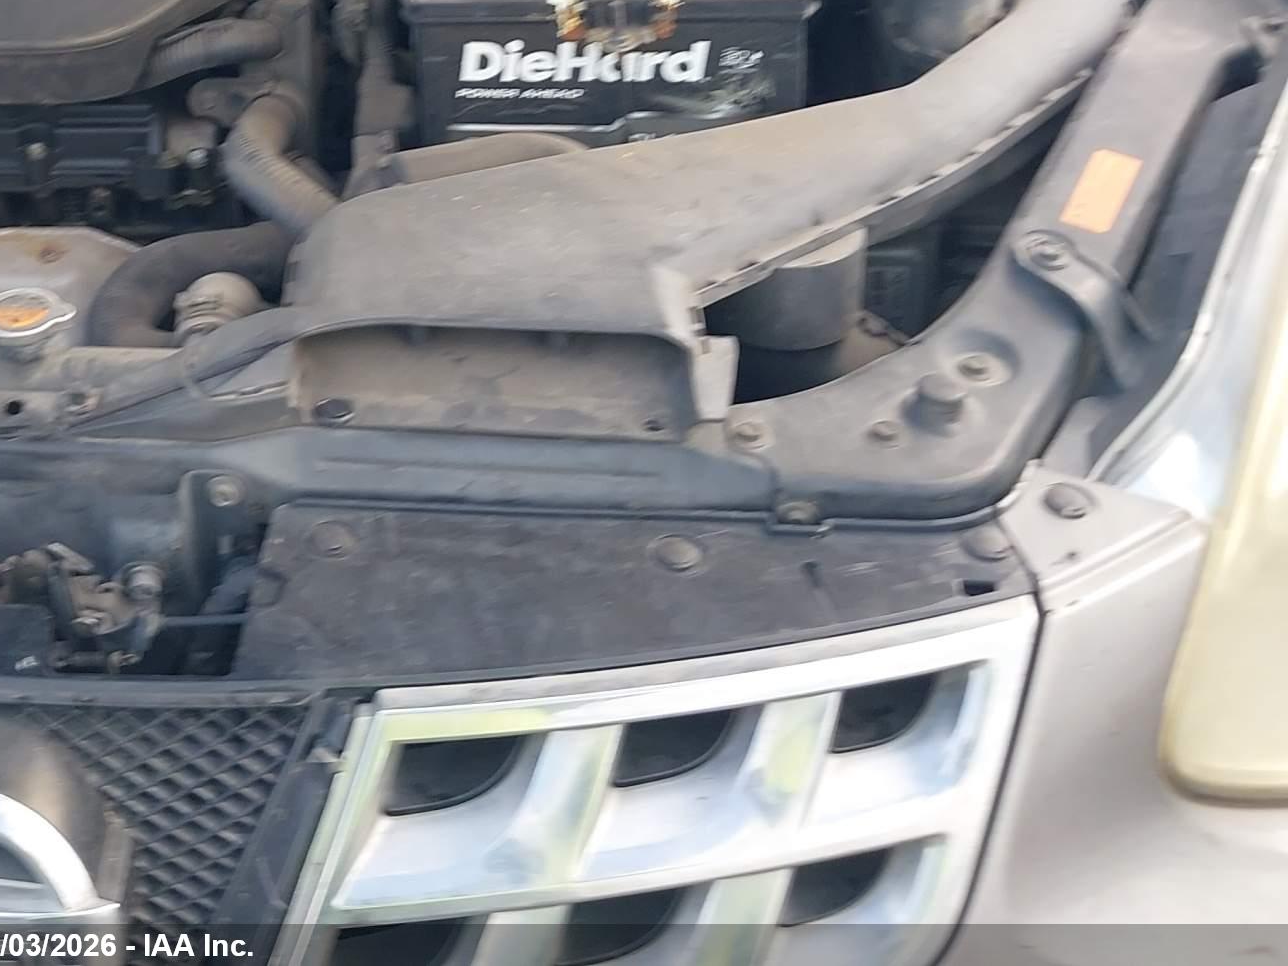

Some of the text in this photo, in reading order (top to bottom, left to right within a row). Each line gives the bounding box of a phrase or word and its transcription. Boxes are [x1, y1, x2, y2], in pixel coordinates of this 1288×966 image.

[459, 39, 712, 83] DieHard
[454, 87, 585, 99] POWER AHEAD
